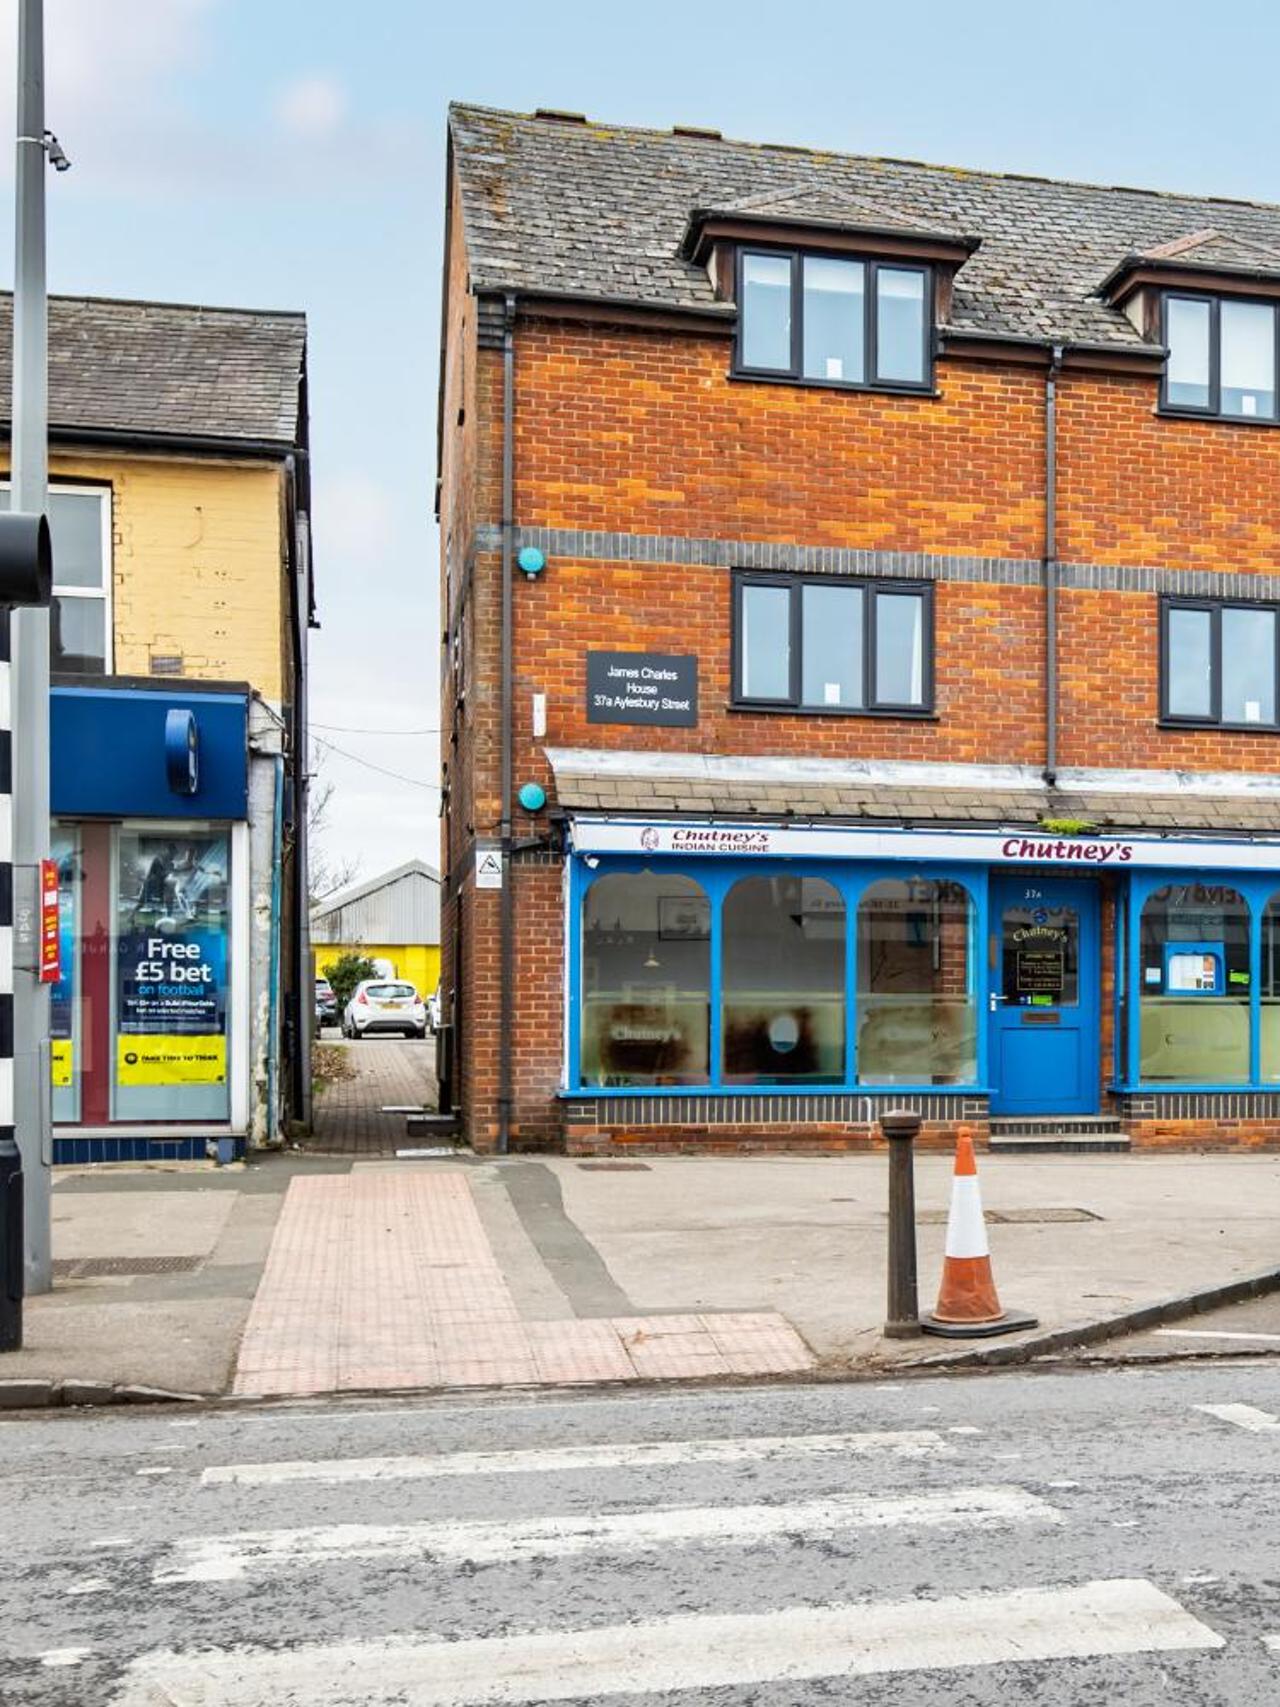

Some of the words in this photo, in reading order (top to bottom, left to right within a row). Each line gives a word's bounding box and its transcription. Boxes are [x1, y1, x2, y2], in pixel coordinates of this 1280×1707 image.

[607, 664, 640, 678] James
[641, 667, 678, 680] Charles
[627, 683, 658, 695] House
[594, 695, 613, 707] 37a
[614, 696, 660, 711] Aylesbury
[661, 698, 690, 711] Street
[673, 830, 769, 844] Chutney's
[672, 842, 716, 851] INDIAN
[718, 844, 769, 852] CUISINE
[1003, 839, 1132, 863] Chutney's
[1013, 927, 1068, 944] Chutney's
[147, 938, 201, 959] Free
[135, 961, 164, 982] £5
[170, 961, 212, 982] bet
[138, 986, 155, 995] on
[158, 984, 204, 996] football
